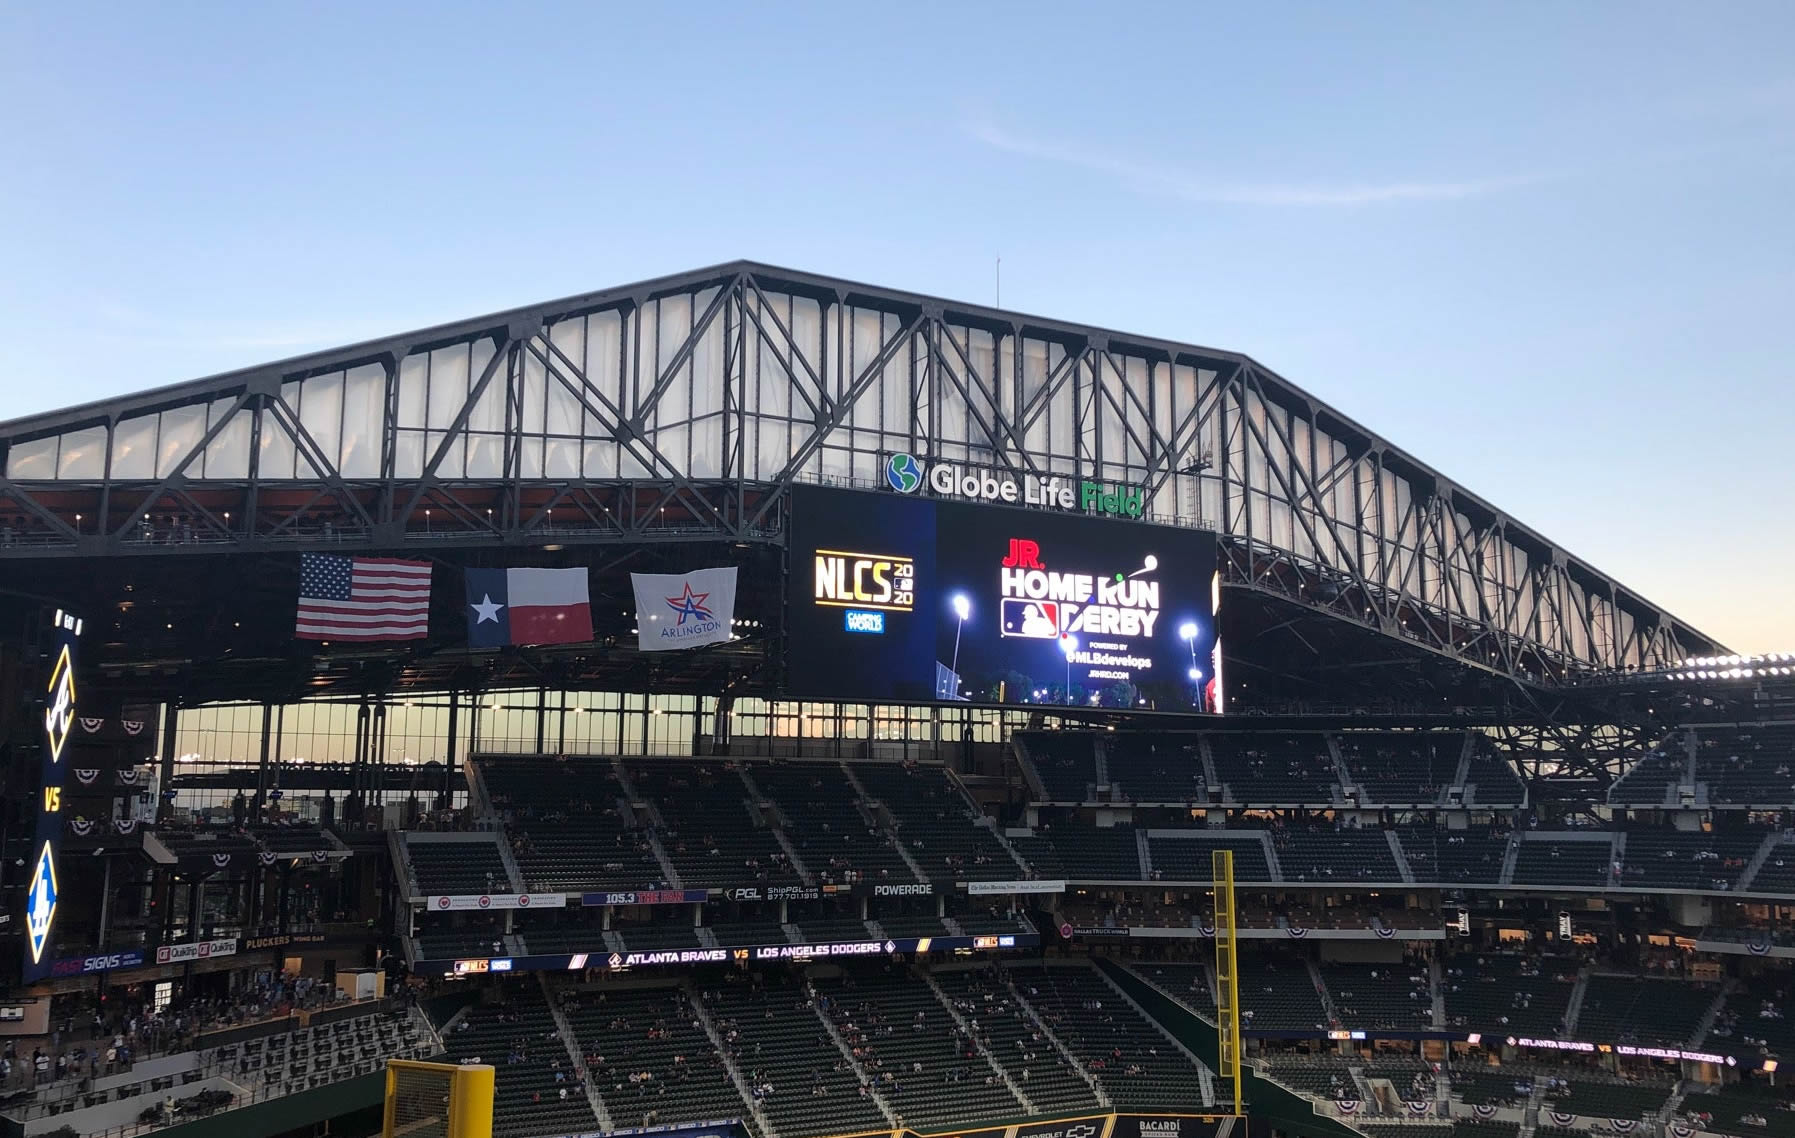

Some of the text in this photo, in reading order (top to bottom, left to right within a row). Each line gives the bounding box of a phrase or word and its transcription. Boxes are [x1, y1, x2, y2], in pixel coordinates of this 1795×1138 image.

[930, 464, 1142, 516] Globe Life Field
[1002, 539, 1045, 569] JR.
[815, 556, 914, 603] NLCS 20
[1001, 567, 1159, 608] HOME RUN
[893, 591, 914, 605] 20
[848, 620, 882, 632] WORLD
[1060, 603, 1159, 637] DERBY
[661, 621, 721, 638] ARLINGTON
[44, 786, 60, 812] VS
[605, 894, 635, 904] 105.3
[637, 892, 657, 903] THE
[735, 888, 761, 899] PGL
[767, 886, 819, 894] ShipPGL.com
[875, 885, 932, 896] POWERADE
[171, 946, 197, 959] QuikTrip
[211, 942, 235, 953] QuikTrip
[246, 936, 290, 949] PLUCKERS
[625, 943, 881, 965] ATLANTA BRAVES VS LOS ANGELES DODGERS
[1519, 1039, 1724, 1063] ATLANTA BRAVES VS LOS ANGELES DODGERS
[1139, 1119, 1181, 1131] BACARDÍ
